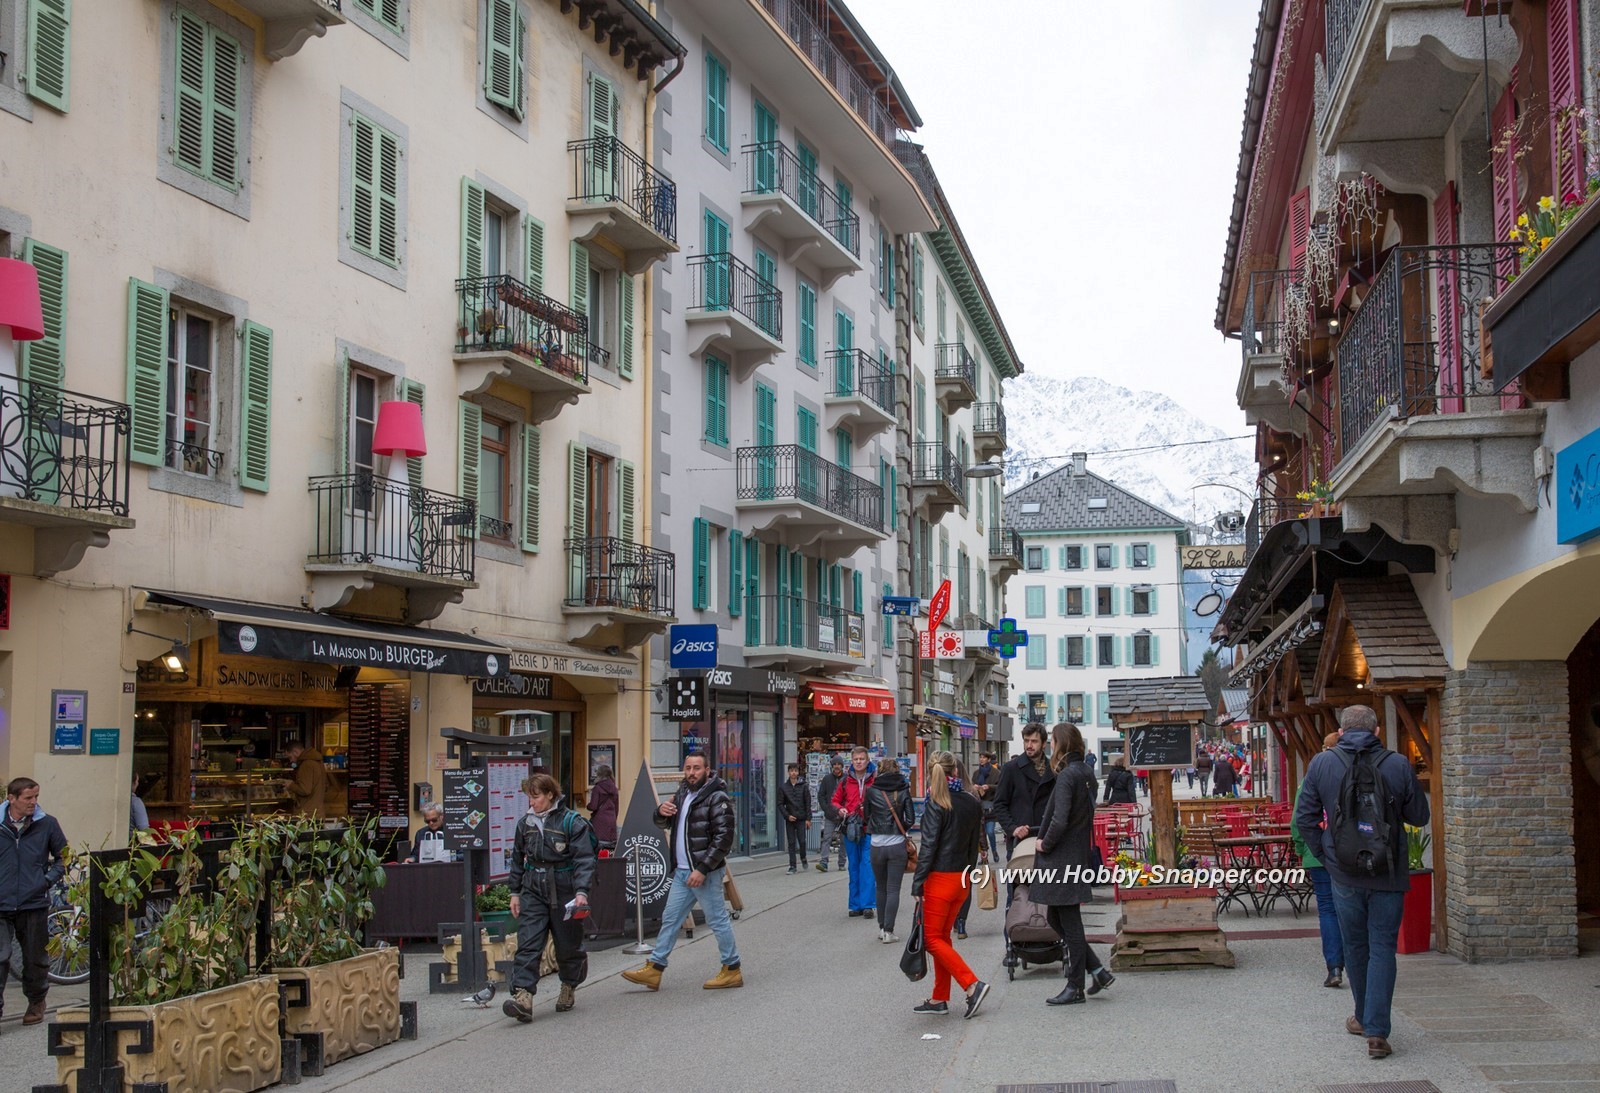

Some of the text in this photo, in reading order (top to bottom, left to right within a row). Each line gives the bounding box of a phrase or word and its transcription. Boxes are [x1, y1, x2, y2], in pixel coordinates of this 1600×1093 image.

[1204, 549, 1248, 569] Calèch
[932, 590, 947, 622] TABAC
[921, 631, 931, 658] BURGER
[937, 632, 961, 643] POCO
[386, 645, 434, 666] BURGER
[937, 646, 961, 657] LOCO
[508, 653, 537, 669] ALERIE
[542, 656, 568, 671] D'ART
[124, 682, 134, 692] 21
[299, 671, 337, 692] PANIN
[522, 676, 550, 697] D'ART
[821, 695, 834, 706] TABAC
[672, 708, 701, 718] Haglöfs
[624, 834, 661, 847] CRÊPES
